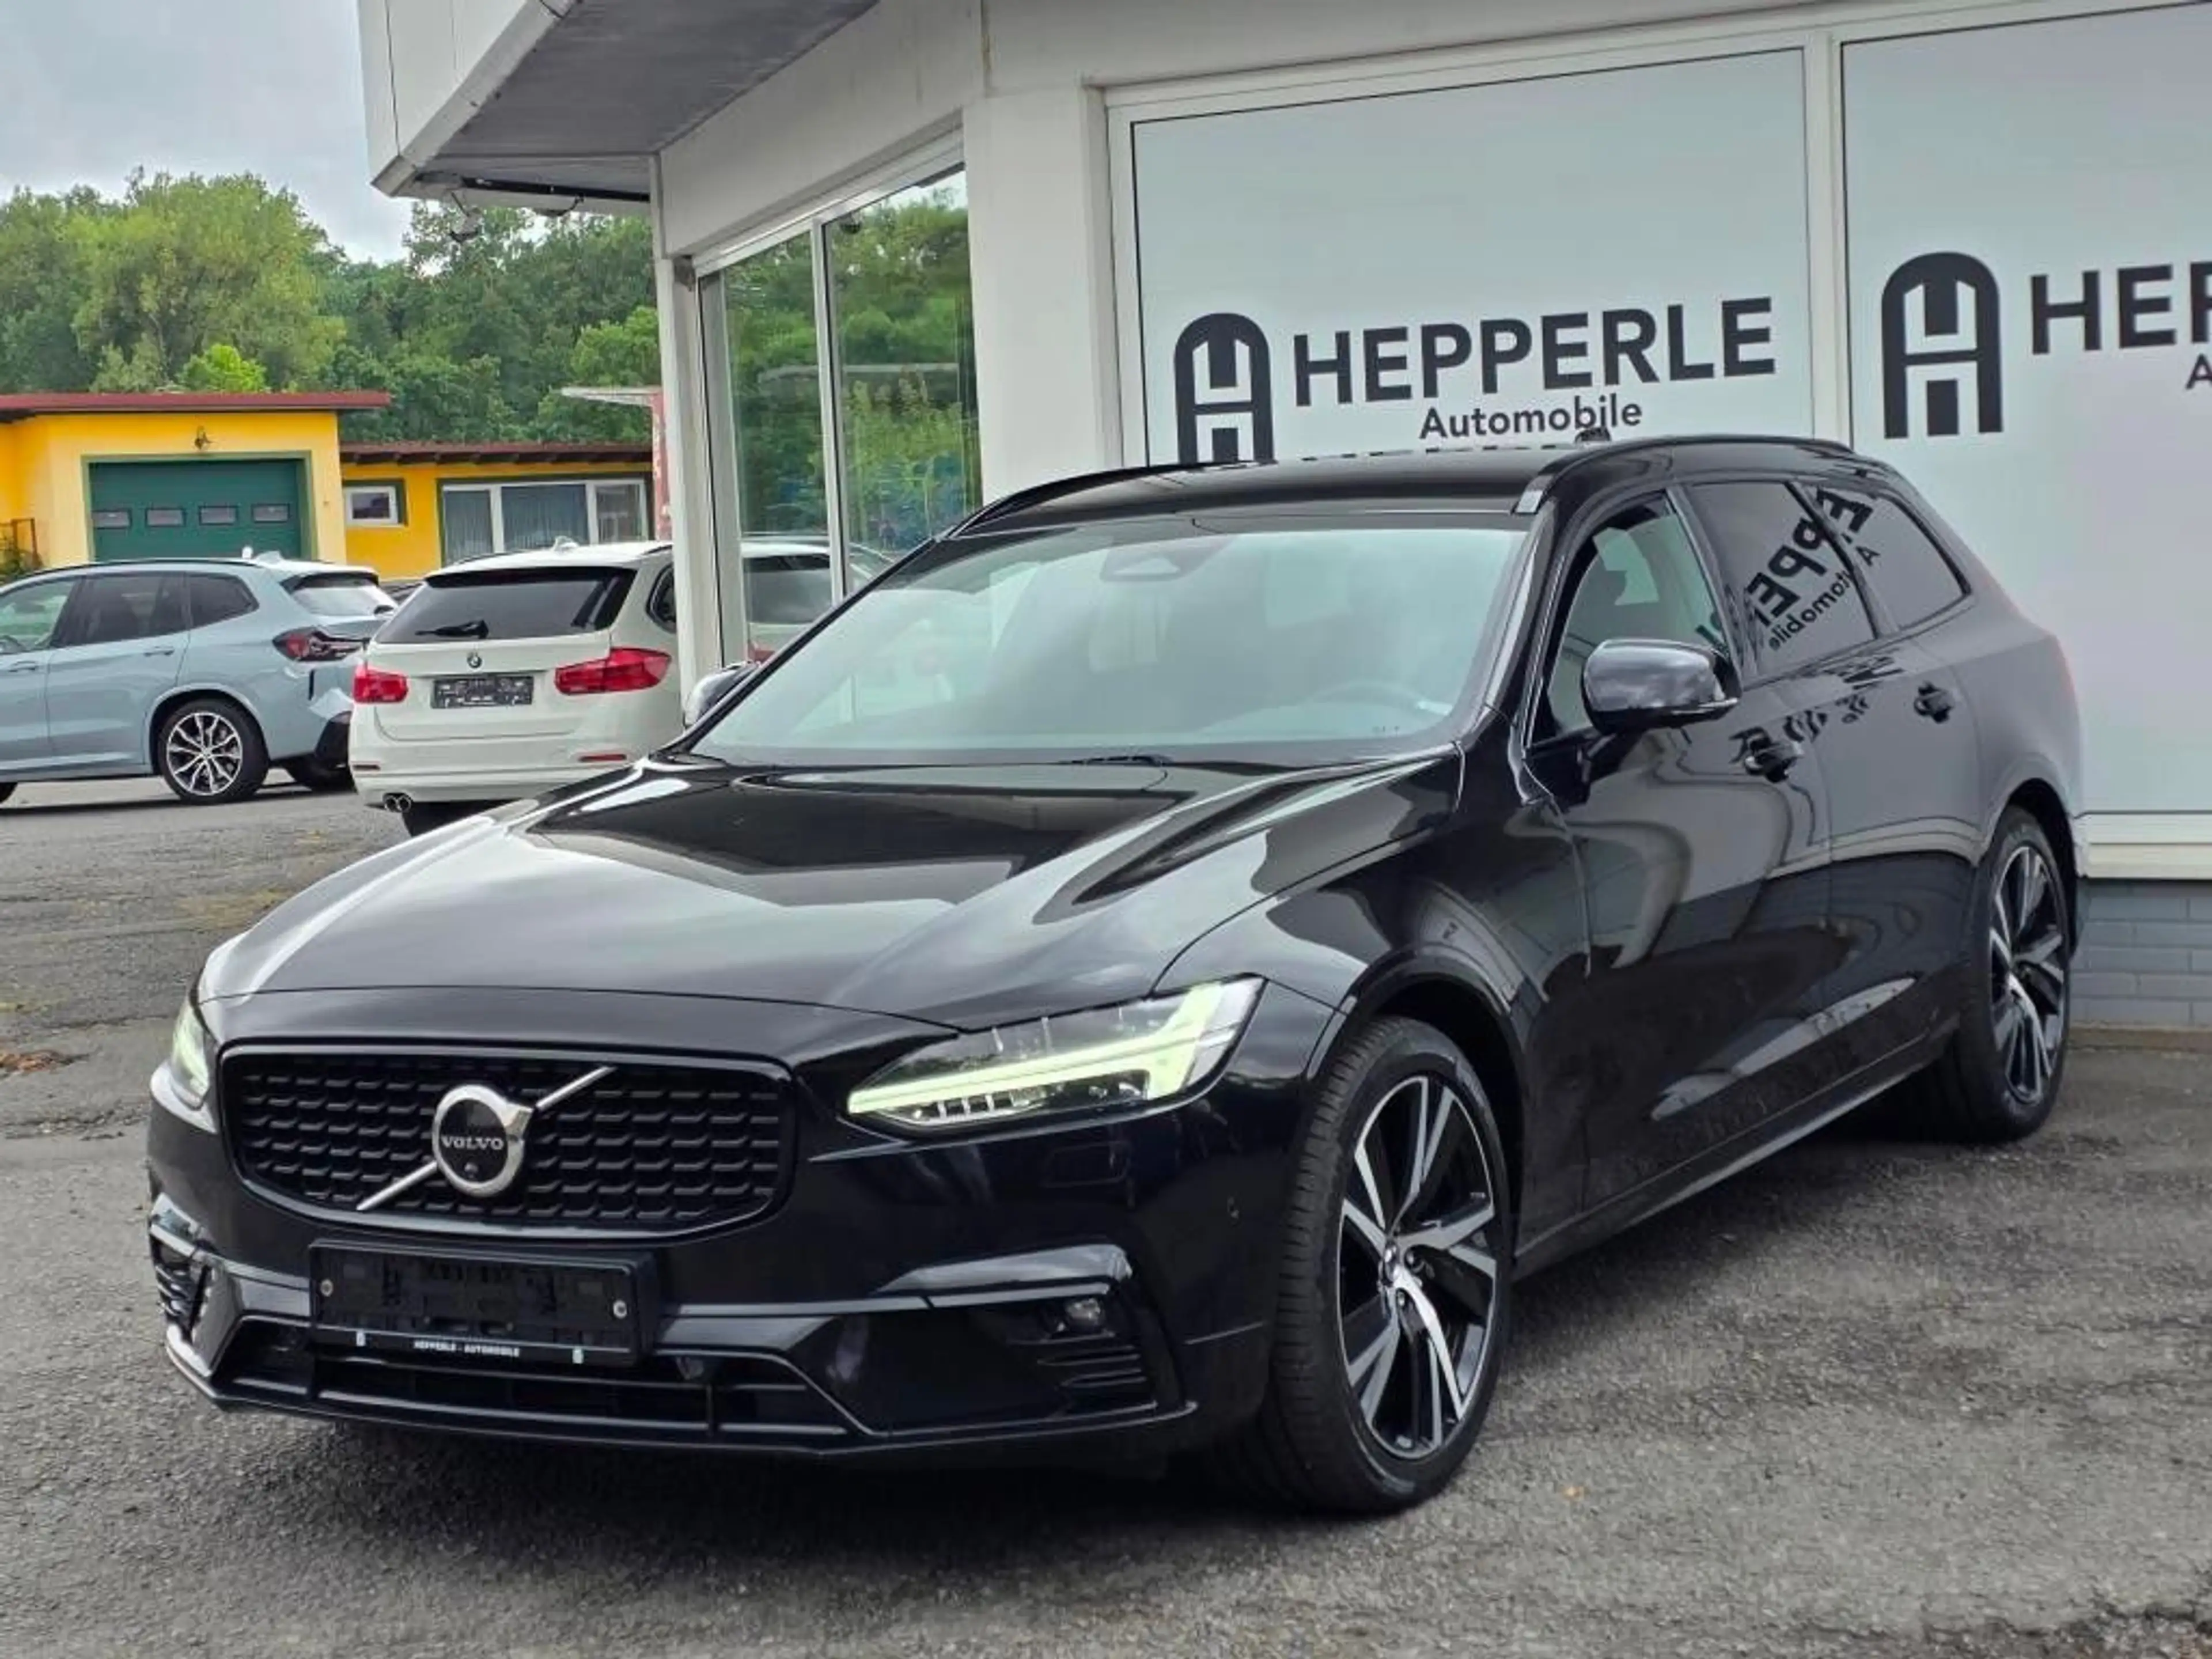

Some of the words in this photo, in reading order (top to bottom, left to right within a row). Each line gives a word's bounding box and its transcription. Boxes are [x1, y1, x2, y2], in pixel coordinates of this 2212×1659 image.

[1294, 297, 1775, 407] HEPPERLE
[1419, 393, 1643, 440] Automobile
[441, 1135, 505, 1150] VOLVO
